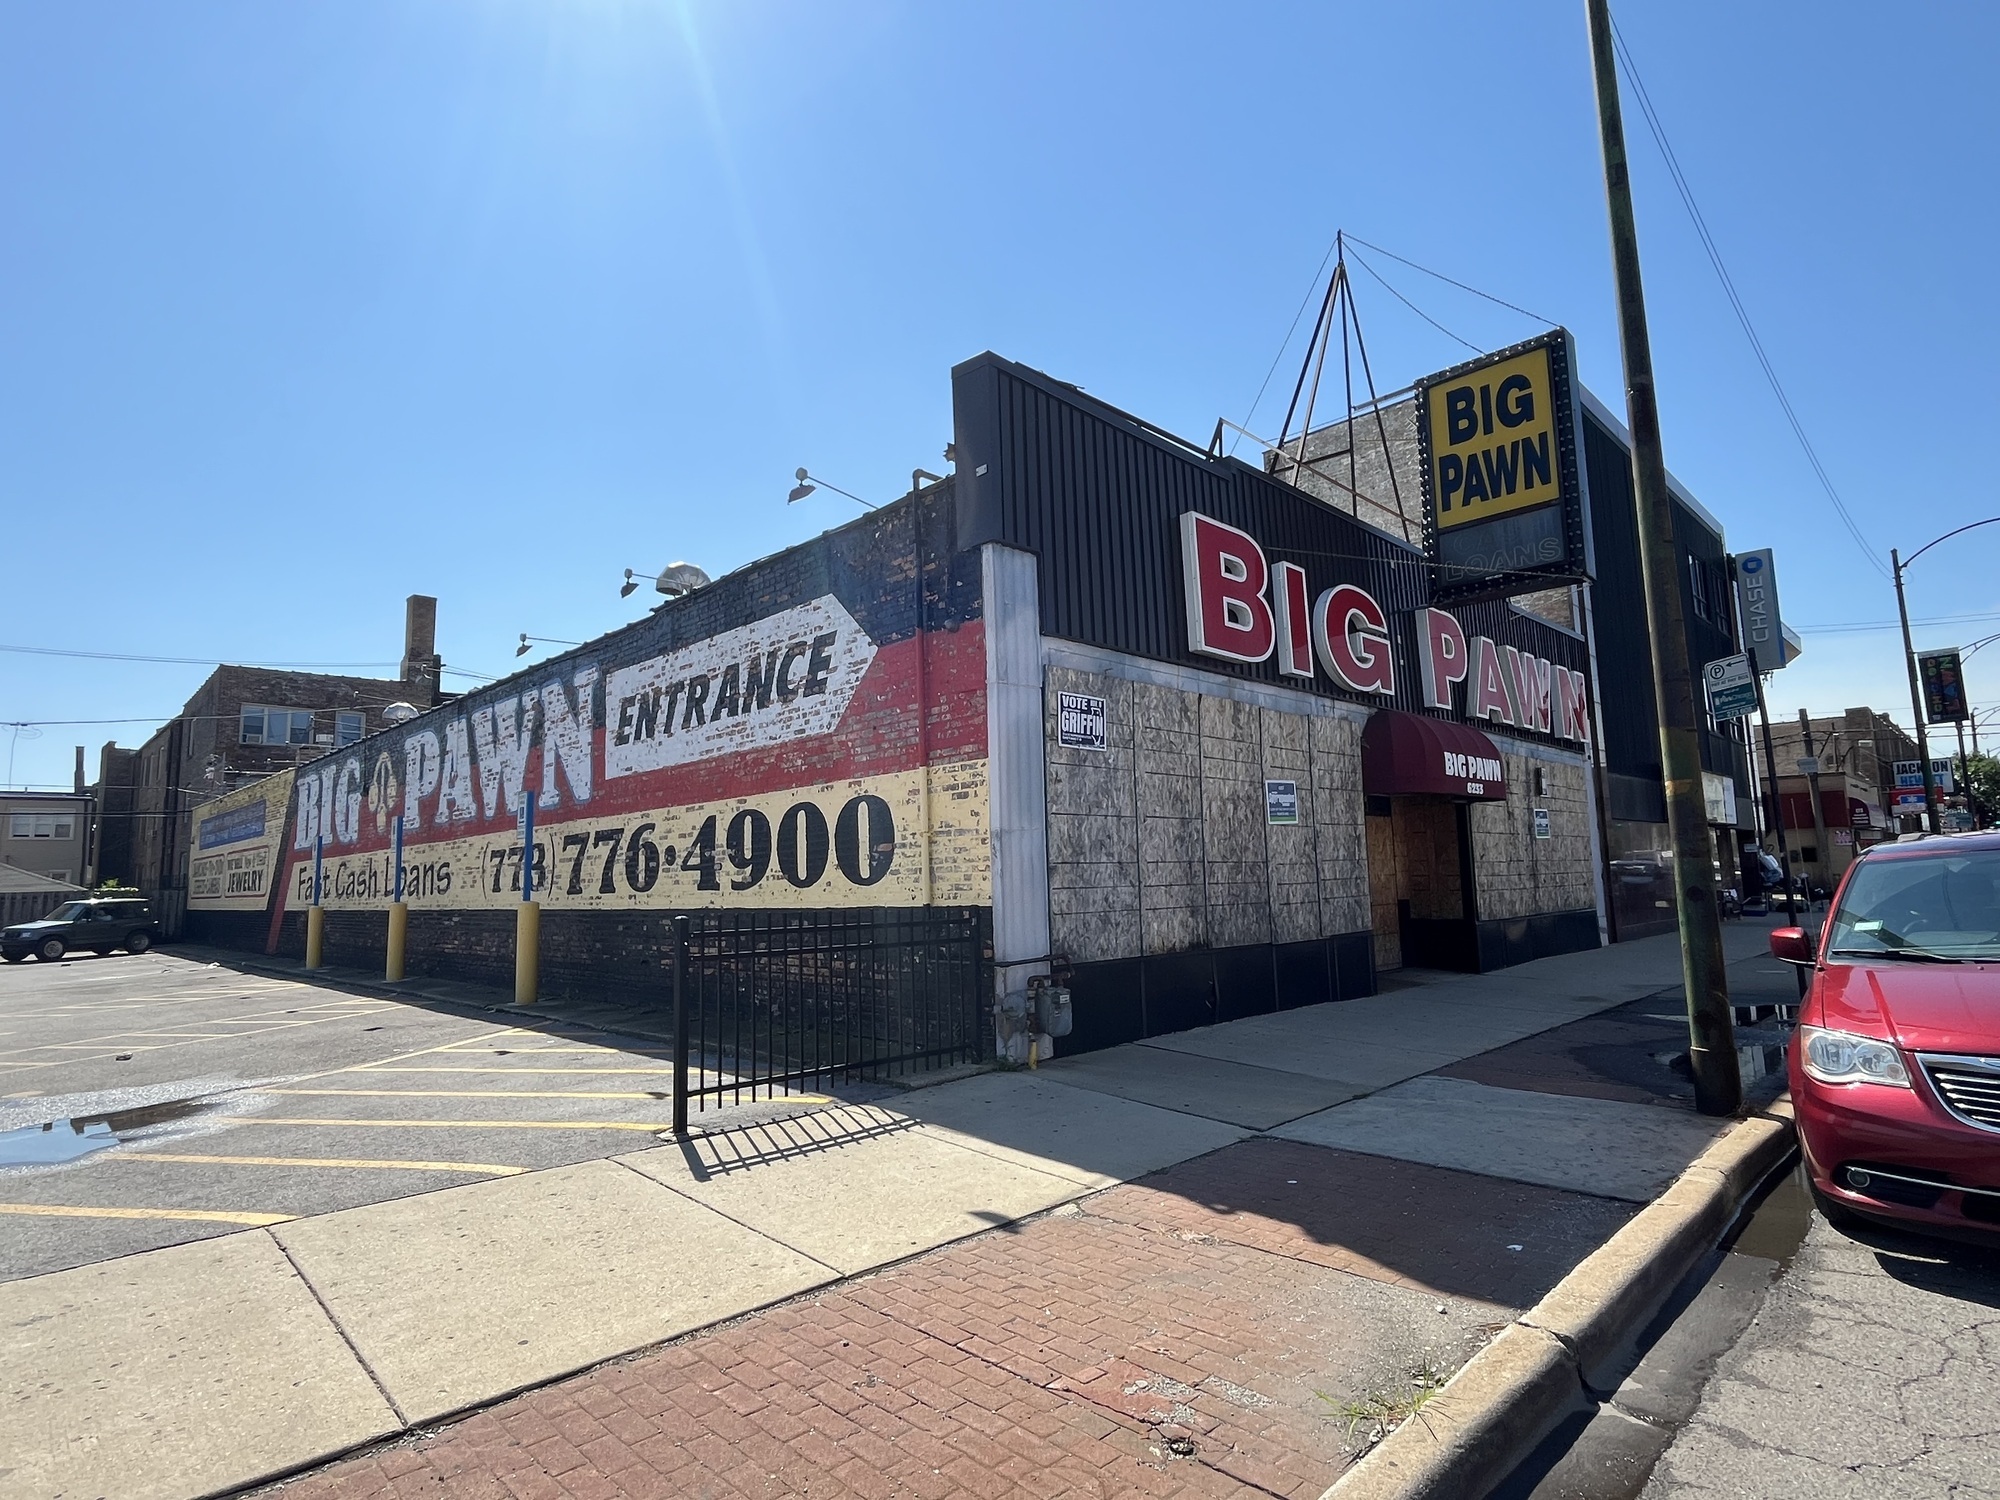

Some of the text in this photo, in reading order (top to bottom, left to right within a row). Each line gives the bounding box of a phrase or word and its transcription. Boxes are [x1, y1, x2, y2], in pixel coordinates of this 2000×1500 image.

[1446, 374, 1535, 446] BIG
[1438, 431, 1552, 512] PAWN
[1445, 537, 1561, 581] LOANS
[1180, 511, 1590, 743] BIG PAWN
[1746, 575, 1769, 642] CHASE
[614, 631, 839, 747] ENTRANCE
[1062, 695, 1088, 710] VOTE
[1062, 711, 1103, 737] GRIFFIN
[293, 664, 600, 850] BIG PAWN
[1443, 751, 1502, 782] BIG PAWN
[1467, 782, 1484, 795] 6233
[227, 868, 264, 893] JEWELRY
[297, 865, 331, 901] Fat
[335, 857, 379, 899] Cash
